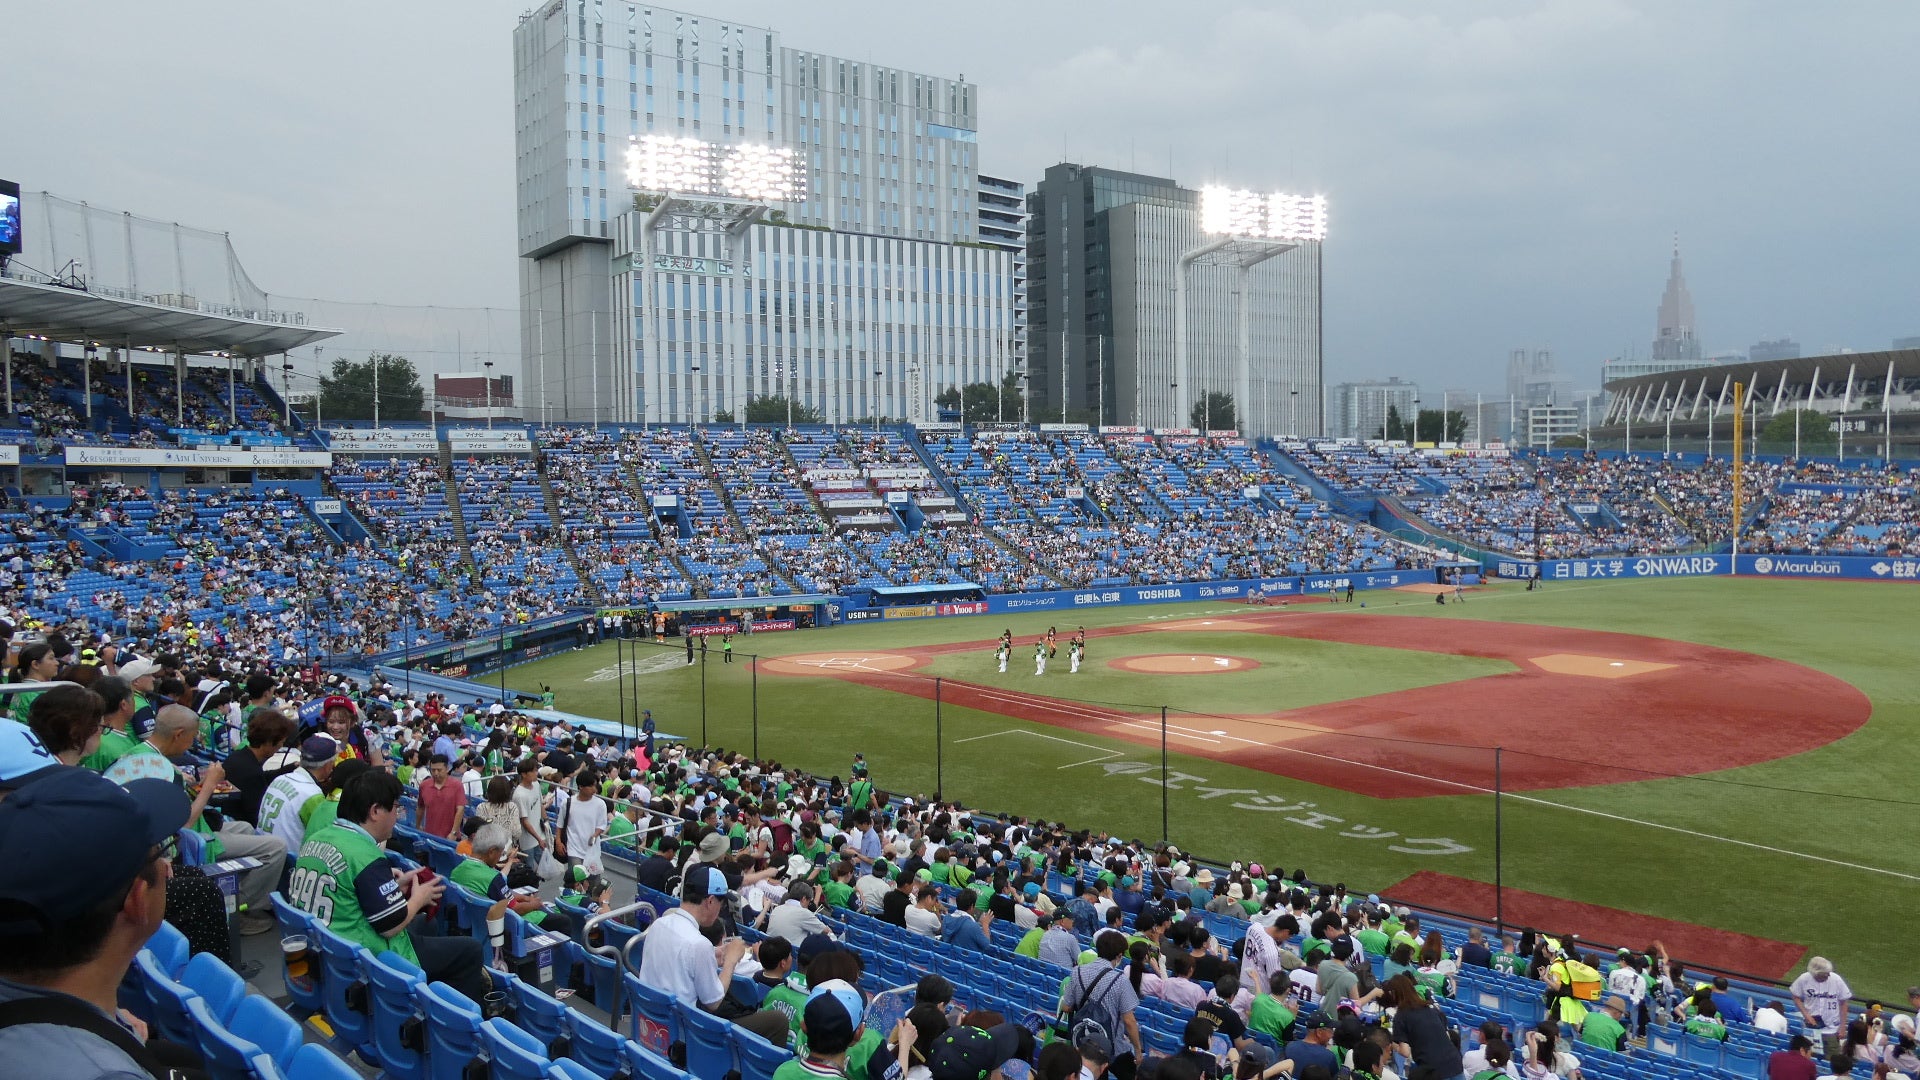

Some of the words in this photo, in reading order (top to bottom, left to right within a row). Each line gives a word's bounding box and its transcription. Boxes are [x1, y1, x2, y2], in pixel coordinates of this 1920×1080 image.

[1634, 557, 1717, 576] ONWARD
[1774, 560, 1841, 574] Marubun
[1892, 560, 1920, 578] 住友
[1260, 582, 1277, 592] Royal
[1278, 581, 1292, 590] Host
[1137, 588, 1181, 600] TOSHIBA
[1007, 597, 1056, 608] 日立ソリューションズ
[848, 611, 867, 620] USEN
[1138, 771, 1478, 855] エイジェック
[1827, 1001, 1837, 1010] 13
